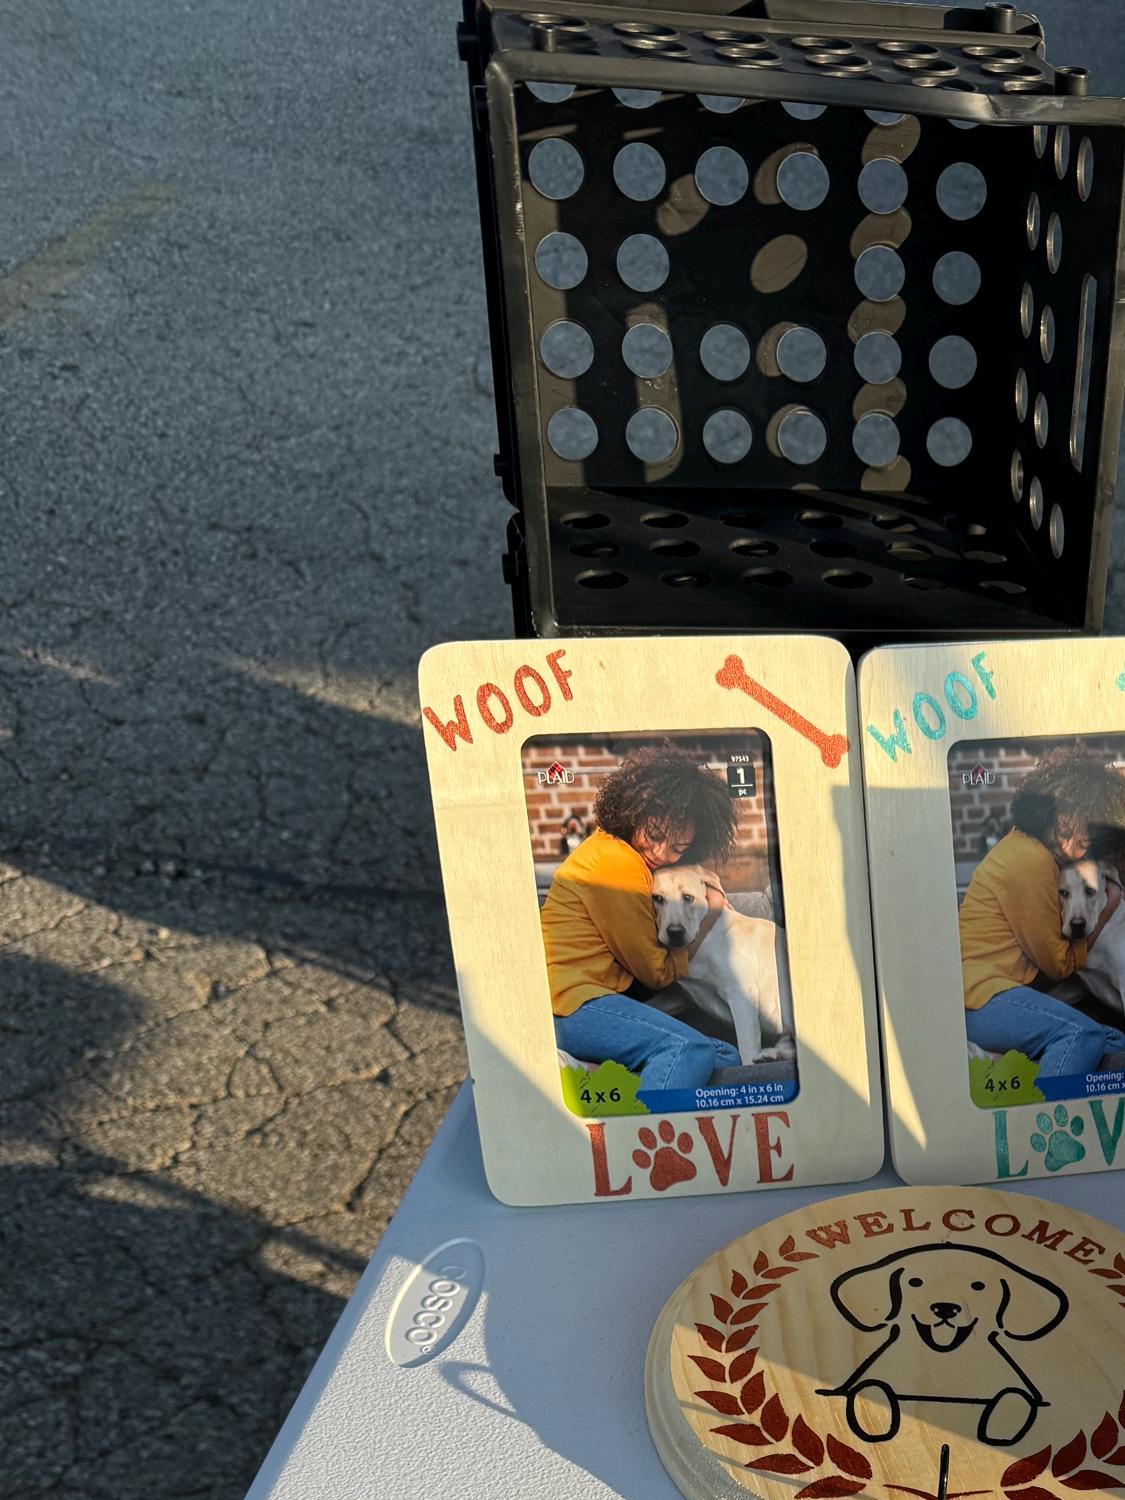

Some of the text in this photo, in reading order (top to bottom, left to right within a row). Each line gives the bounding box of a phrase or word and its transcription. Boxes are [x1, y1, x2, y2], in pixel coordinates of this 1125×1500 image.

[422, 648, 574, 752] WOOF
[866, 651, 998, 763] WOOF
[537, 770, 576, 786] PLAID
[736, 767, 745, 785] 1
[962, 771, 996, 786] PLAID
[738, 788, 748, 797] pc
[985, 1076, 1021, 1092] 4 x 6
[1086, 1072, 1124, 1083] Opening:
[695, 1087, 739, 1098] Opening:
[740, 1086, 747, 1095] 4
[748, 1085, 758, 1095] in
[766, 1084, 773, 1092] 6
[774, 1083, 784, 1092] in
[1086, 1082, 1107, 1093] 10.16
[1108, 1082, 1120, 1091] cm
[580, 1088, 621, 1103] 4 x 6
[695, 1098, 719, 1108] 10.16
[720, 1099, 735, 1107] cm
[744, 1094, 768, 1104] 15.24
[770, 1094, 785, 1103] cm
[805, 1208, 1106, 1265] WELCOME
